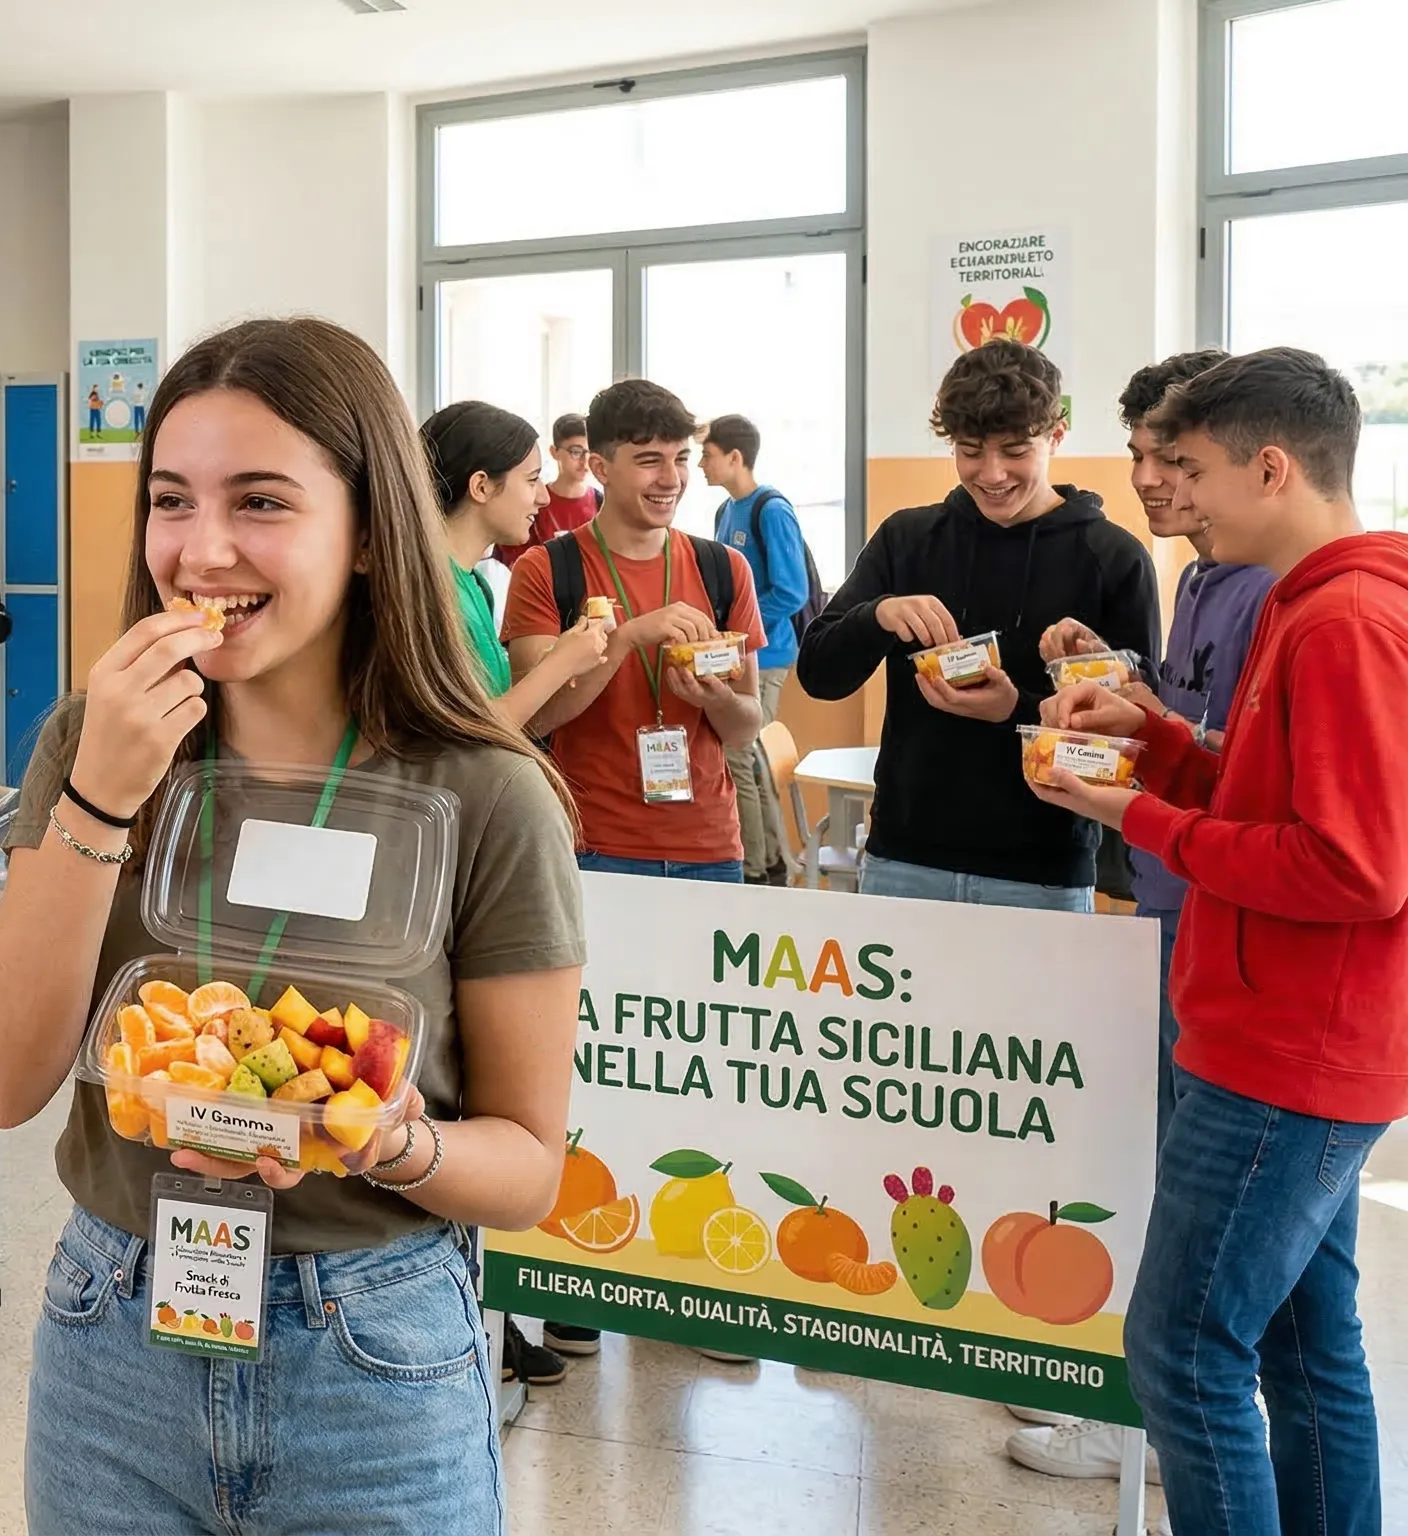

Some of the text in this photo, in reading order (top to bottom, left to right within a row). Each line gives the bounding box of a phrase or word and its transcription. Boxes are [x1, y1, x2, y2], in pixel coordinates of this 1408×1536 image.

[712, 928, 913, 1003] MAAS:
[578, 988, 1084, 1089] A FRUTTA SICILIANA
[190, 1106, 207, 1120] IV
[211, 1110, 274, 1132] Gamma
[573, 1042, 1055, 1143] NELLA TUA SCUOLA
[170, 1216, 251, 1251] MAAS
[186, 1270, 218, 1284] Snack
[518, 1266, 1105, 1388] FILIERA CORTA, QUALITÀ, STAGIONALITÀ, TERRITORIO
